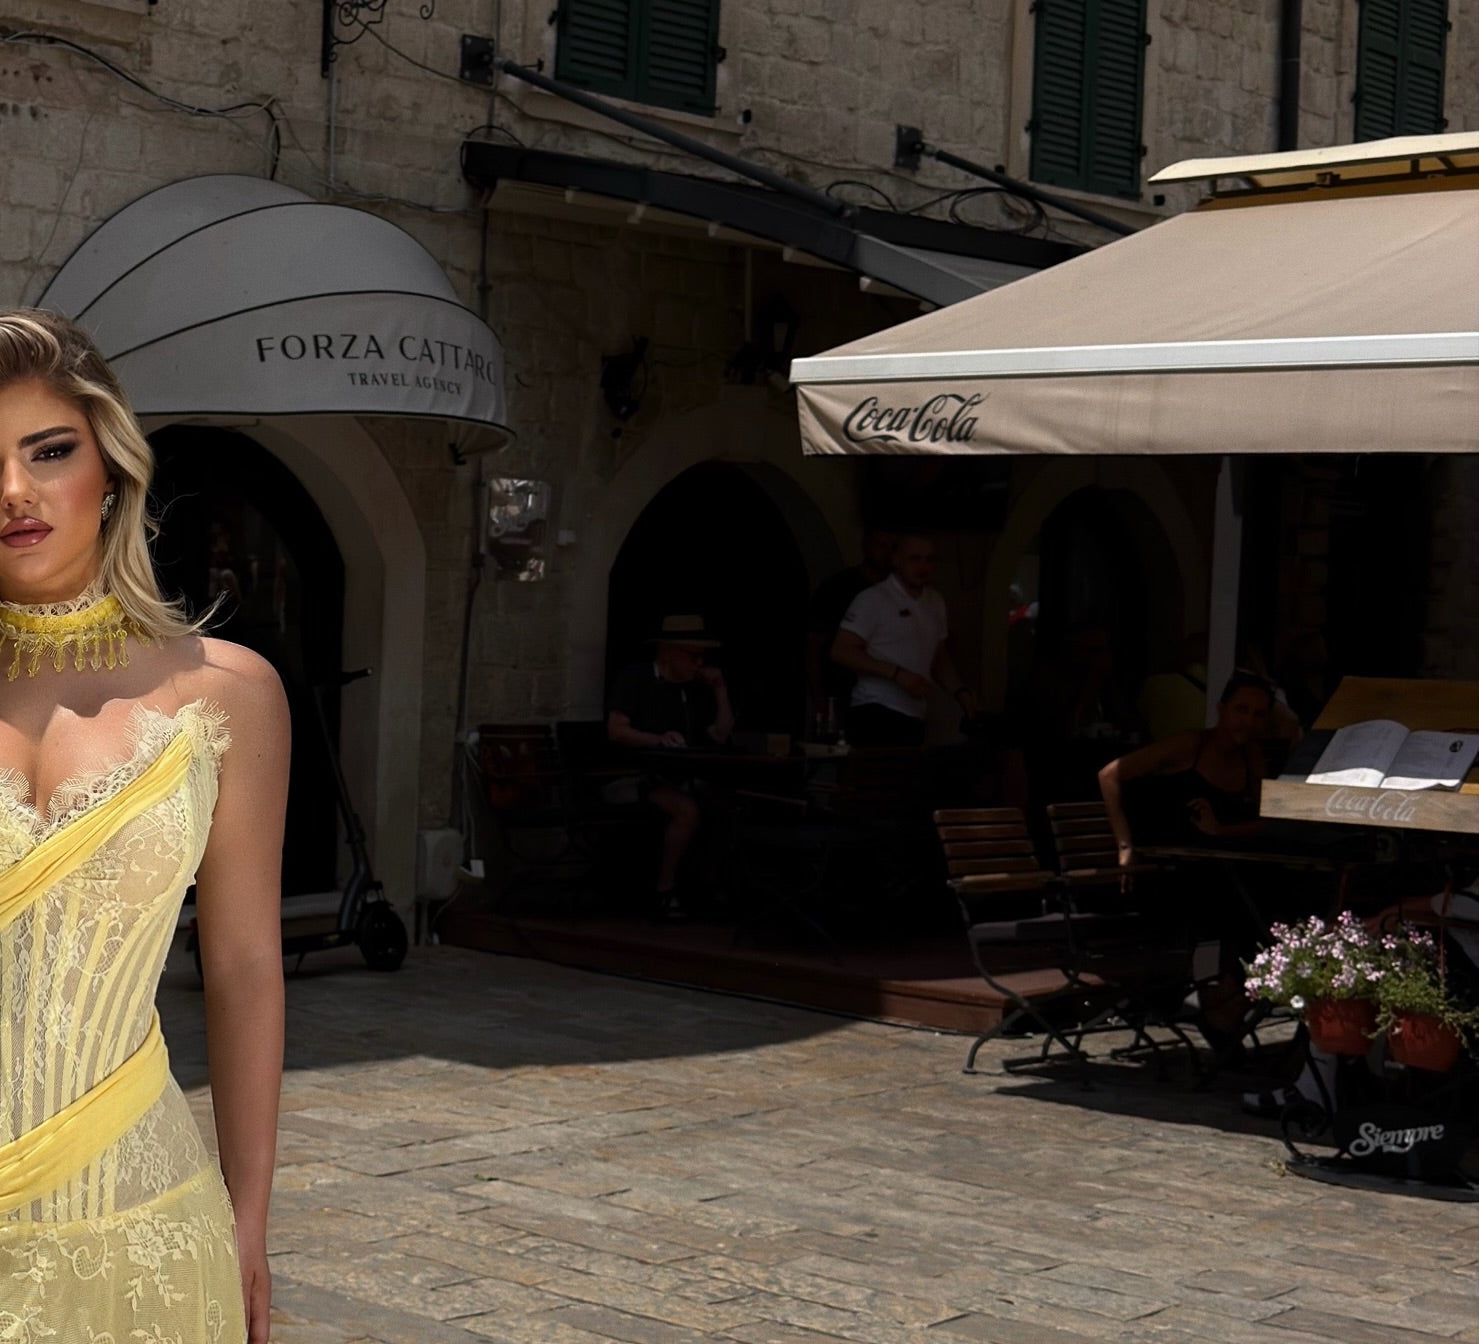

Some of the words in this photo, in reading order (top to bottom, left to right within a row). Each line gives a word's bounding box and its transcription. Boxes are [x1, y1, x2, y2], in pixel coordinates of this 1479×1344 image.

[256, 334, 385, 362] FORZA
[347, 372, 409, 387] TRAVEL
[415, 376, 462, 395] AGENCY
[843, 392, 990, 444] Coca-Cola
[1348, 1122, 1446, 1157] Siempre
